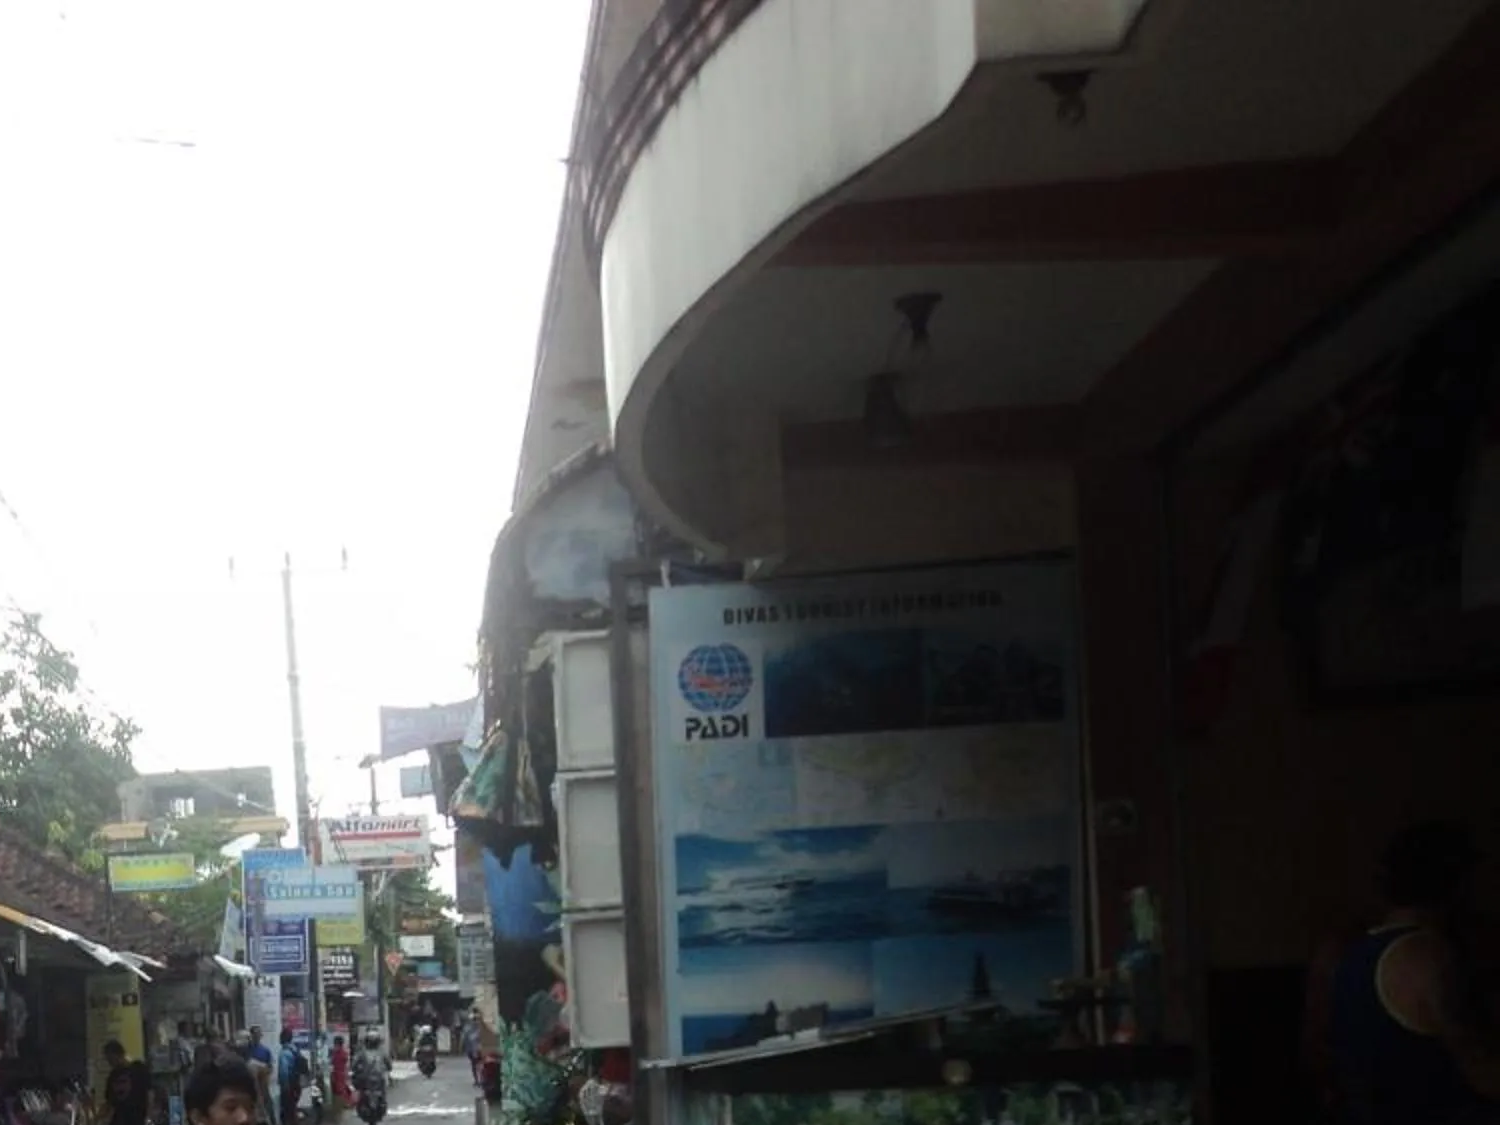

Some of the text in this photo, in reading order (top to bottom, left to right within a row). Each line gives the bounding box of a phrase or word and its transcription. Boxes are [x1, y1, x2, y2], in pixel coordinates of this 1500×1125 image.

[722, 604, 779, 625] DIVAS
[685, 714, 749, 741] PADI
[329, 817, 421, 832] Alfamart
